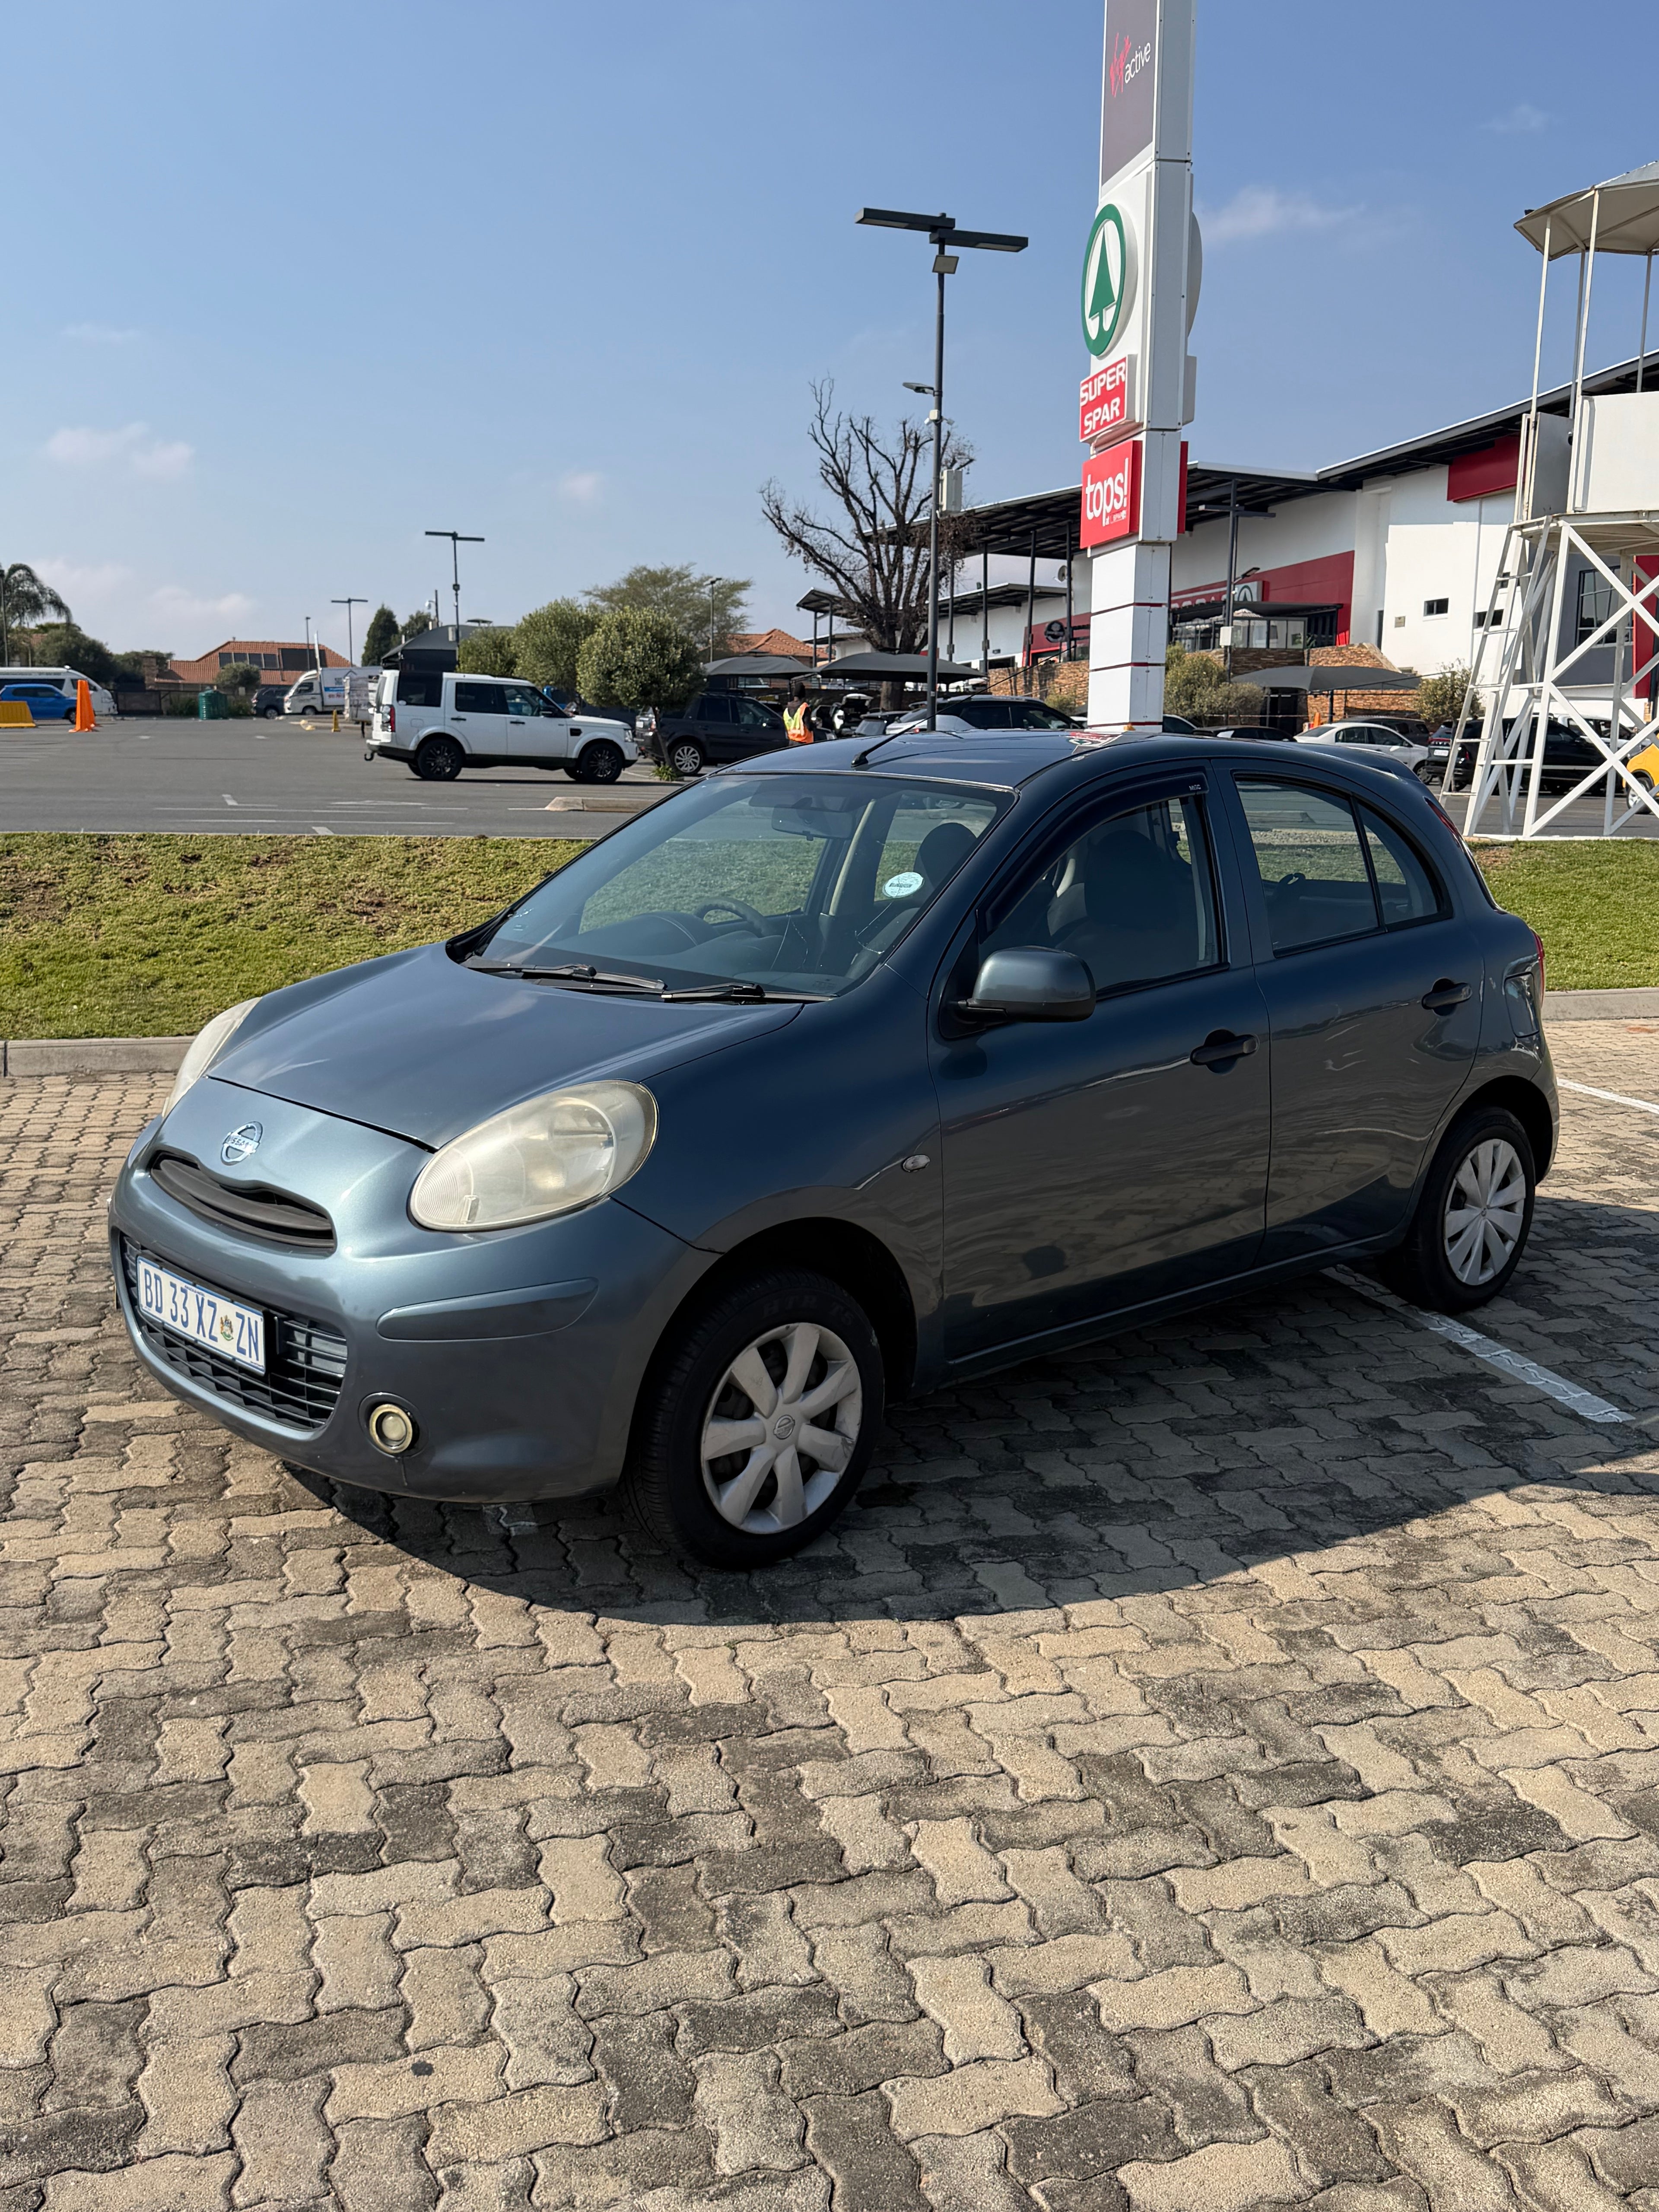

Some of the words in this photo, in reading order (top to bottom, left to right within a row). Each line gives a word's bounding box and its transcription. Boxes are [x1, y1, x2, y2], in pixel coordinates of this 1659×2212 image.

[1125, 42, 1151, 84] active
[1080, 361, 1126, 407] SUPER
[1084, 397, 1120, 435] SPAR
[1085, 458, 1129, 527] tops!
[144, 1268, 163, 1314] BD
[170, 1281, 189, 1328] 33
[196, 1294, 218, 1343] XZ
[235, 1311, 259, 1361] ZN
